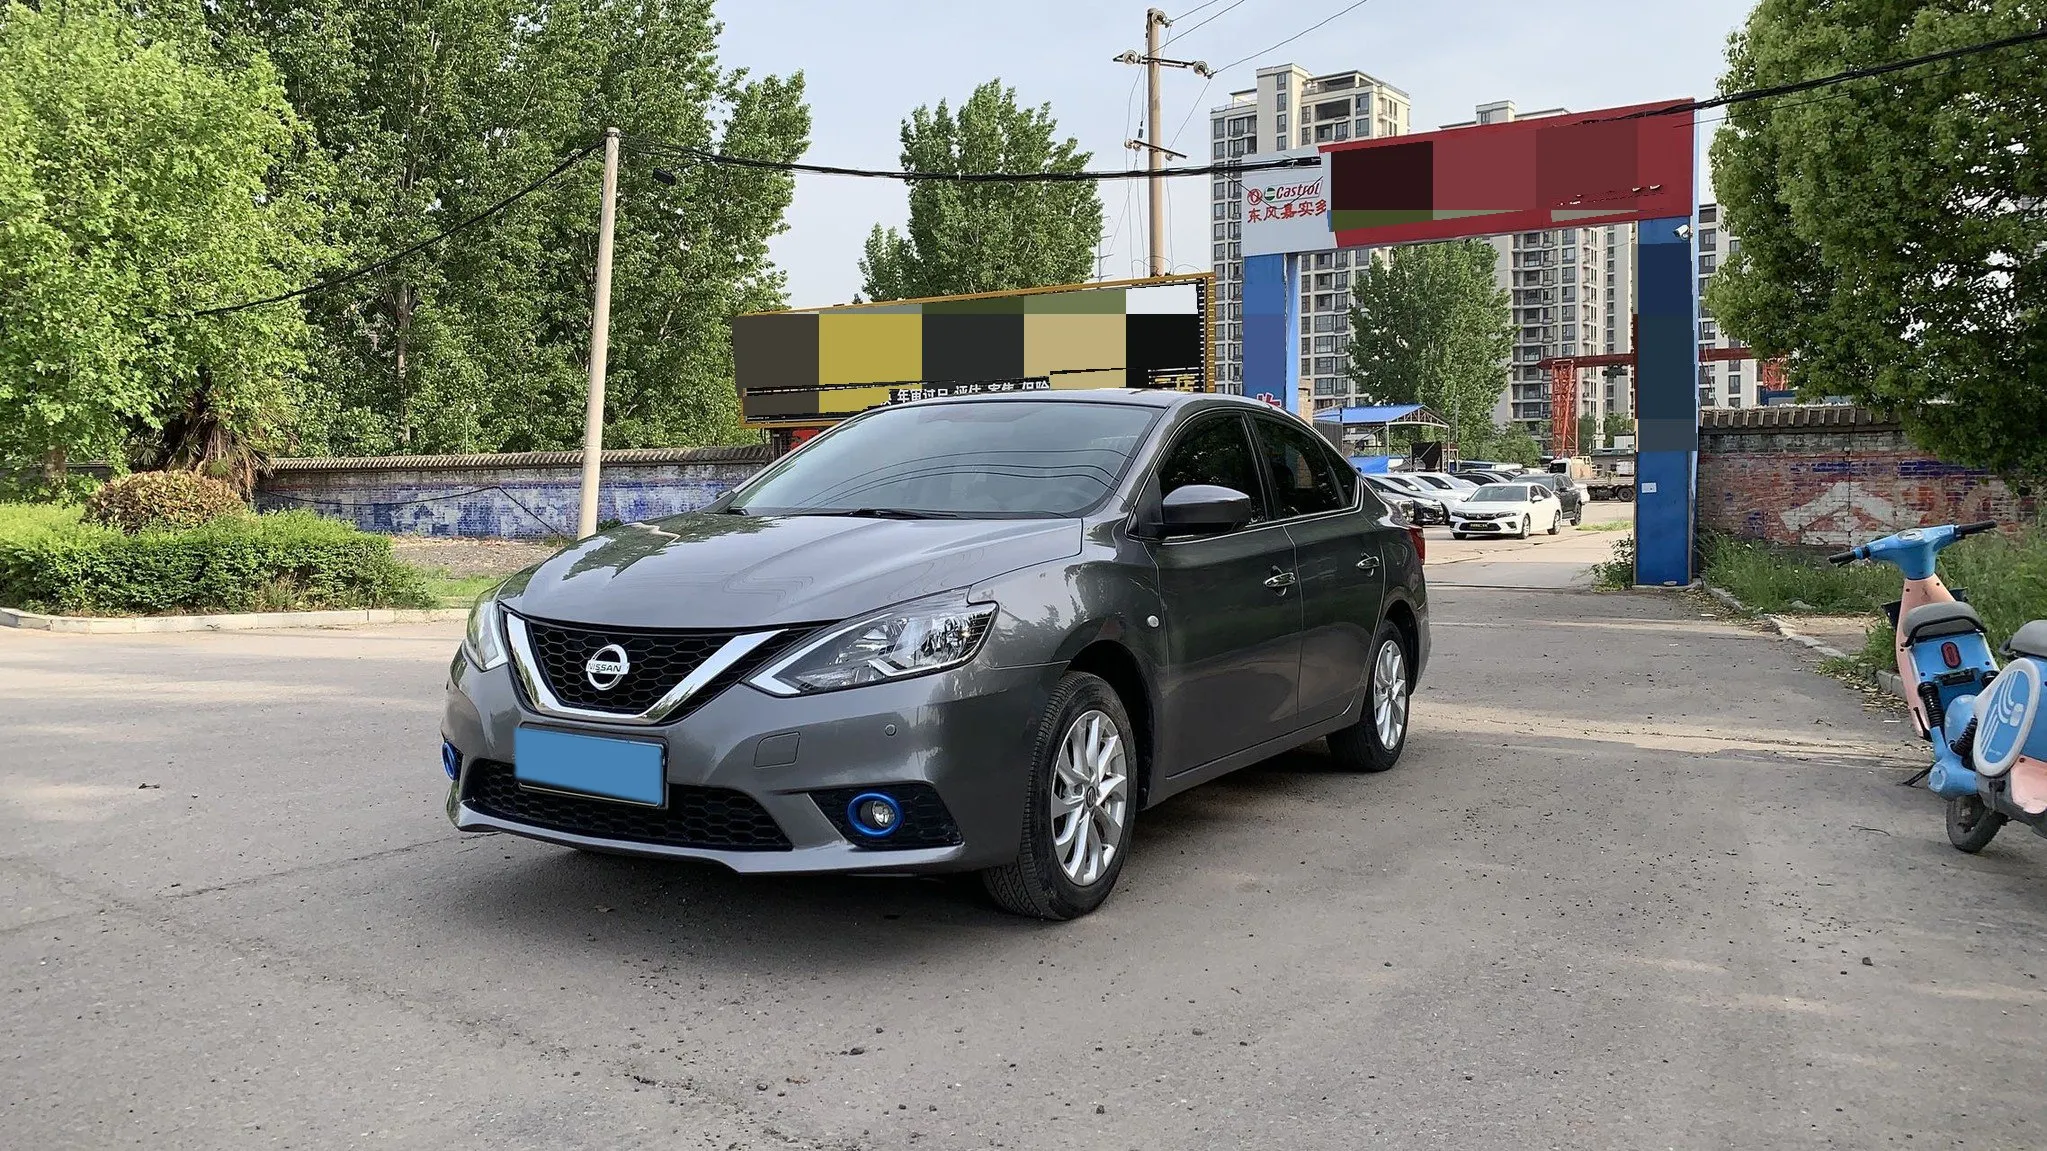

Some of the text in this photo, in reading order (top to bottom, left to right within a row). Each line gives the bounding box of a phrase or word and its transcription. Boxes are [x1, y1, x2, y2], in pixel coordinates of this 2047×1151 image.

[1276, 182, 1321, 200] Castrol
[1247, 199, 1327, 223] 东风嘉实多
[589, 663, 621, 672] NISSAN
